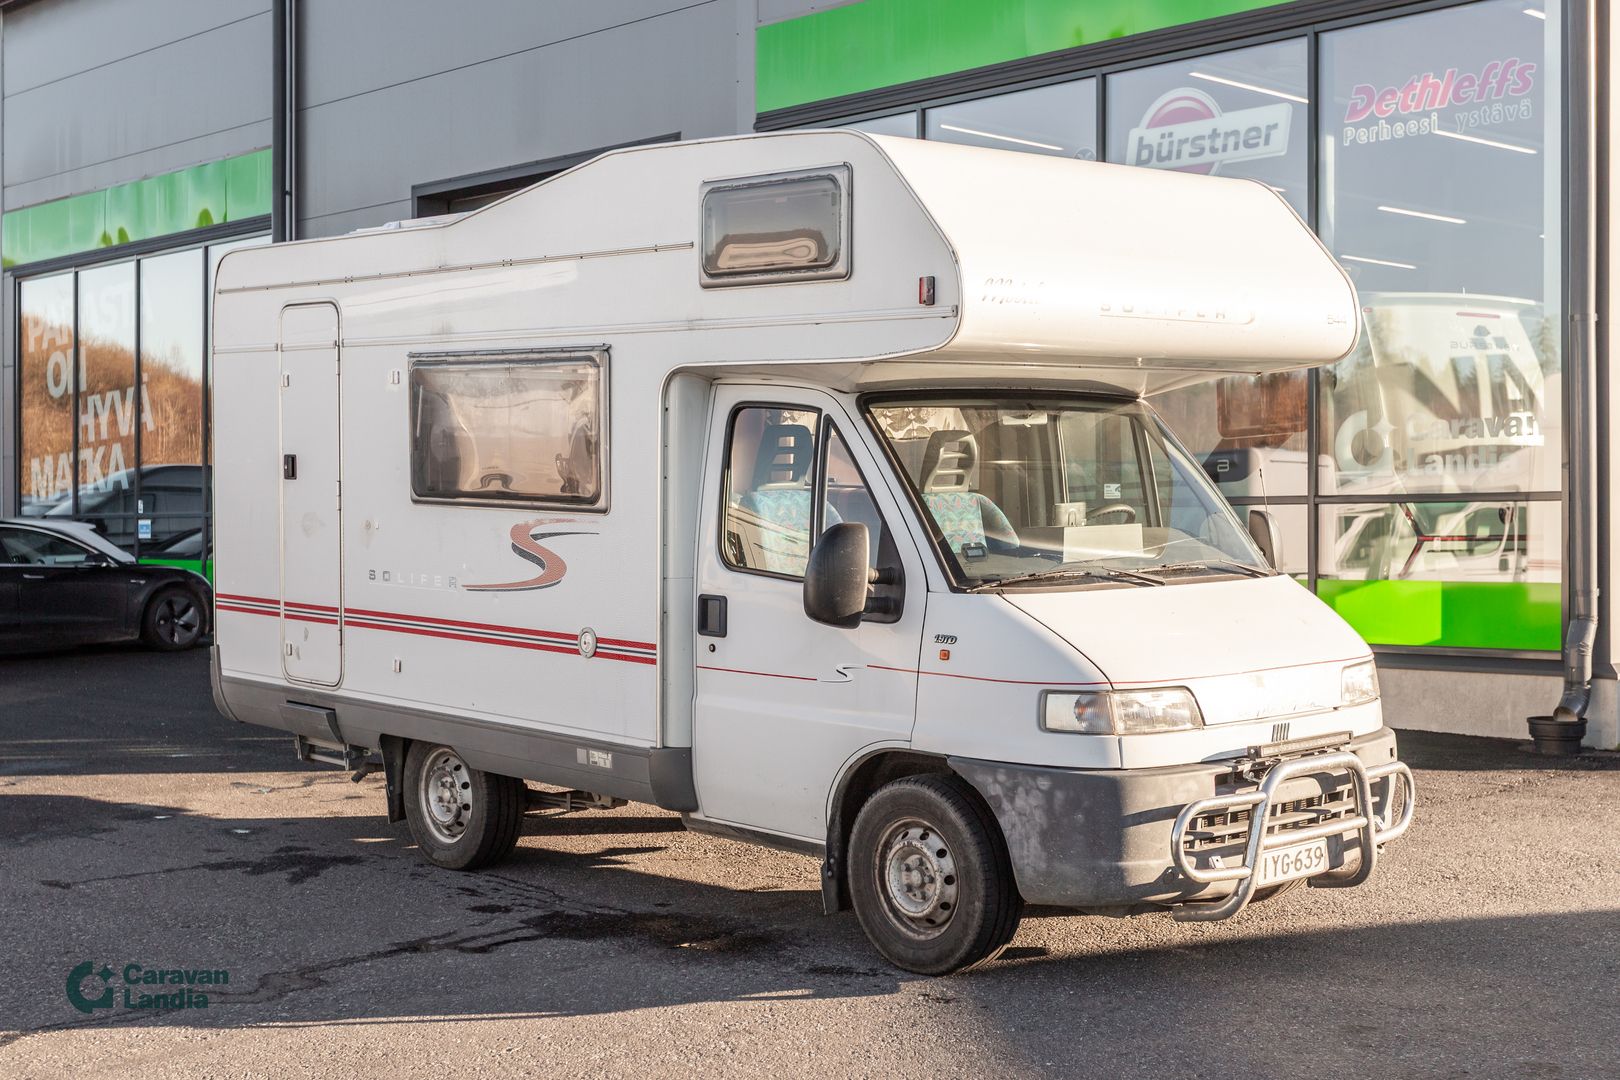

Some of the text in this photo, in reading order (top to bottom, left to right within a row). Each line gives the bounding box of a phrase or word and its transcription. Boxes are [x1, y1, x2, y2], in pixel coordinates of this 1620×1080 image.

[1344, 57, 1537, 124] Dethleffs
[1135, 118, 1281, 166] bürstner
[1343, 99, 1532, 147] Perheesi ystävä
[77, 372, 156, 443] HYVÄ
[29, 442, 130, 503] MATKA
